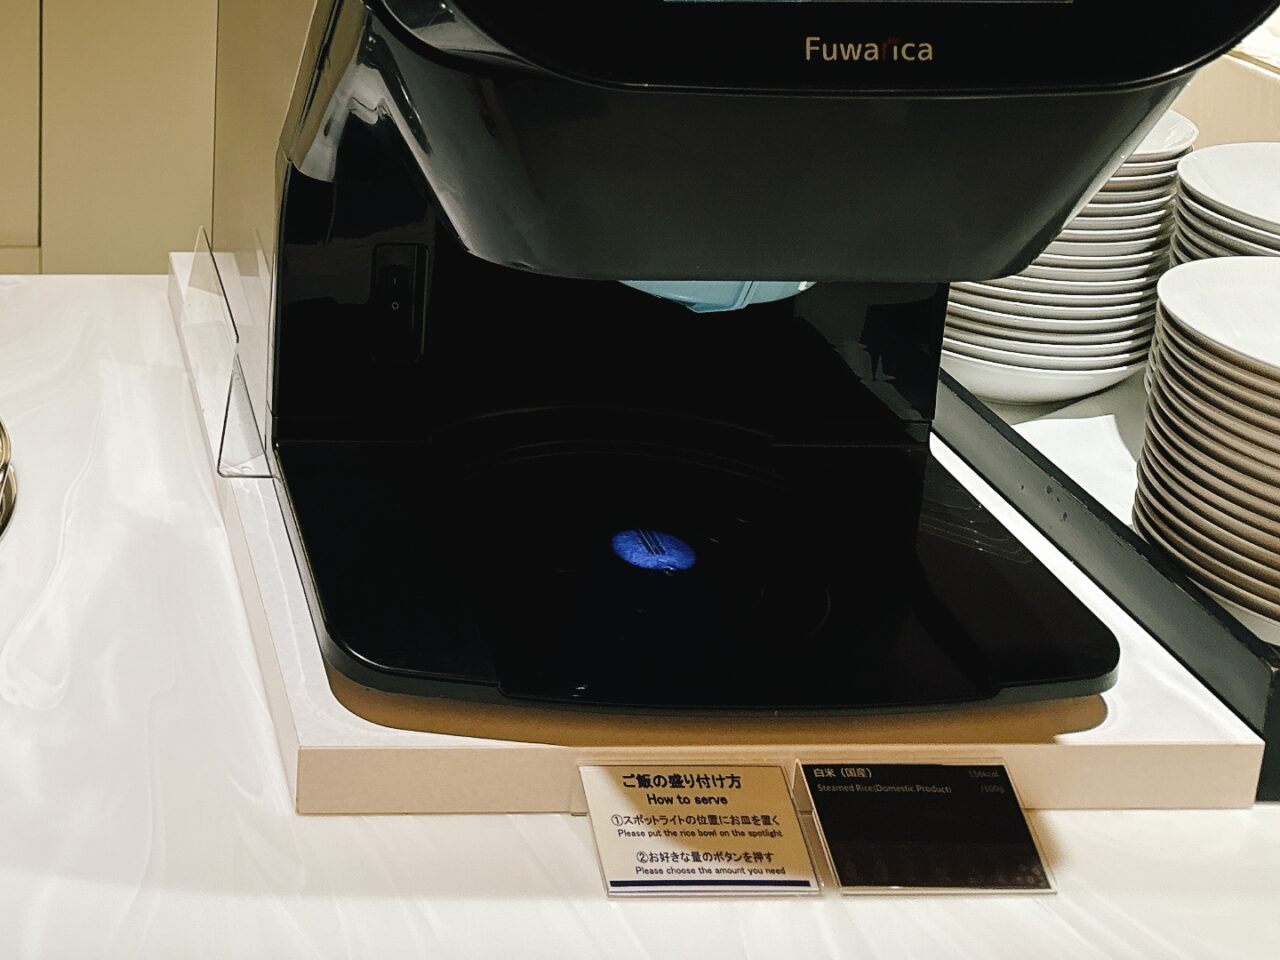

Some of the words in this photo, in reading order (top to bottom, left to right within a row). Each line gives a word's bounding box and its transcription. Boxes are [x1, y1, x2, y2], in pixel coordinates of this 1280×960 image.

[805, 37, 933, 61] Fuwarica
[622, 774, 742, 789] ご飯の盛り付け方
[818, 784, 854, 792] Steamed
[647, 794, 674, 805] How
[677, 795, 691, 805] to
[694, 796, 728, 805] serve
[618, 829, 646, 837] Please
[648, 829, 662, 838] put
[664, 829, 678, 837] the
[680, 829, 696, 837] rice
[698, 829, 717, 837] bowl
[731, 829, 746, 837] the
[748, 829, 783, 839] spotlight
[635, 866, 664, 875] Please
[666, 866, 696, 875] choose
[698, 866, 712, 875] the
[715, 867, 746, 875] amount
[749, 868, 763, 876] you
[765, 866, 786, 875] need
